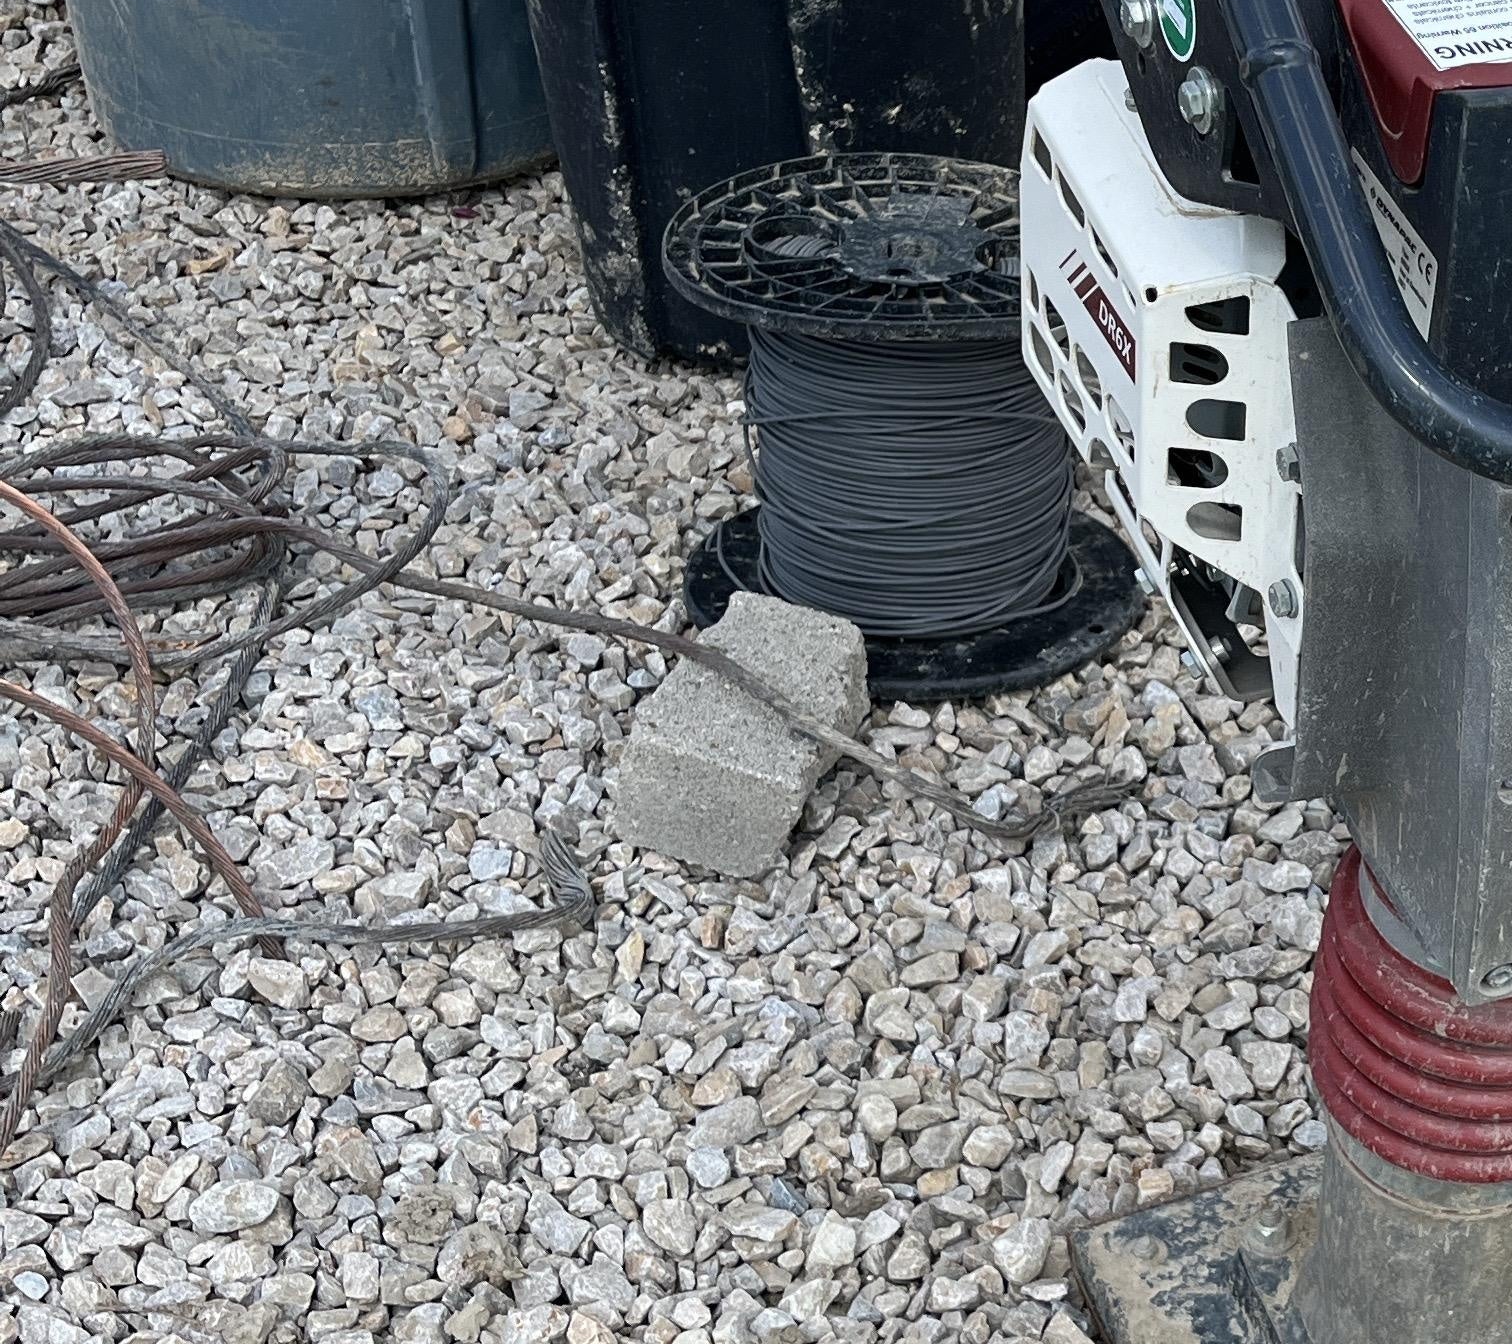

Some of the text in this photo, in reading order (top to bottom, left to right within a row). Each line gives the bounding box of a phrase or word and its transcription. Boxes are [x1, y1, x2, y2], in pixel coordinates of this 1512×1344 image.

[1475, 0, 1508, 8] cancer
[1412, 7, 1463, 17] chemicals
[1466, 7, 1508, 17] contains
[1413, 14, 1464, 24] chemicals
[1416, 29, 1462, 39] Warning
[1375, 196, 1418, 255] DYNAPAC
[1098, 298, 1132, 366] DR6X
